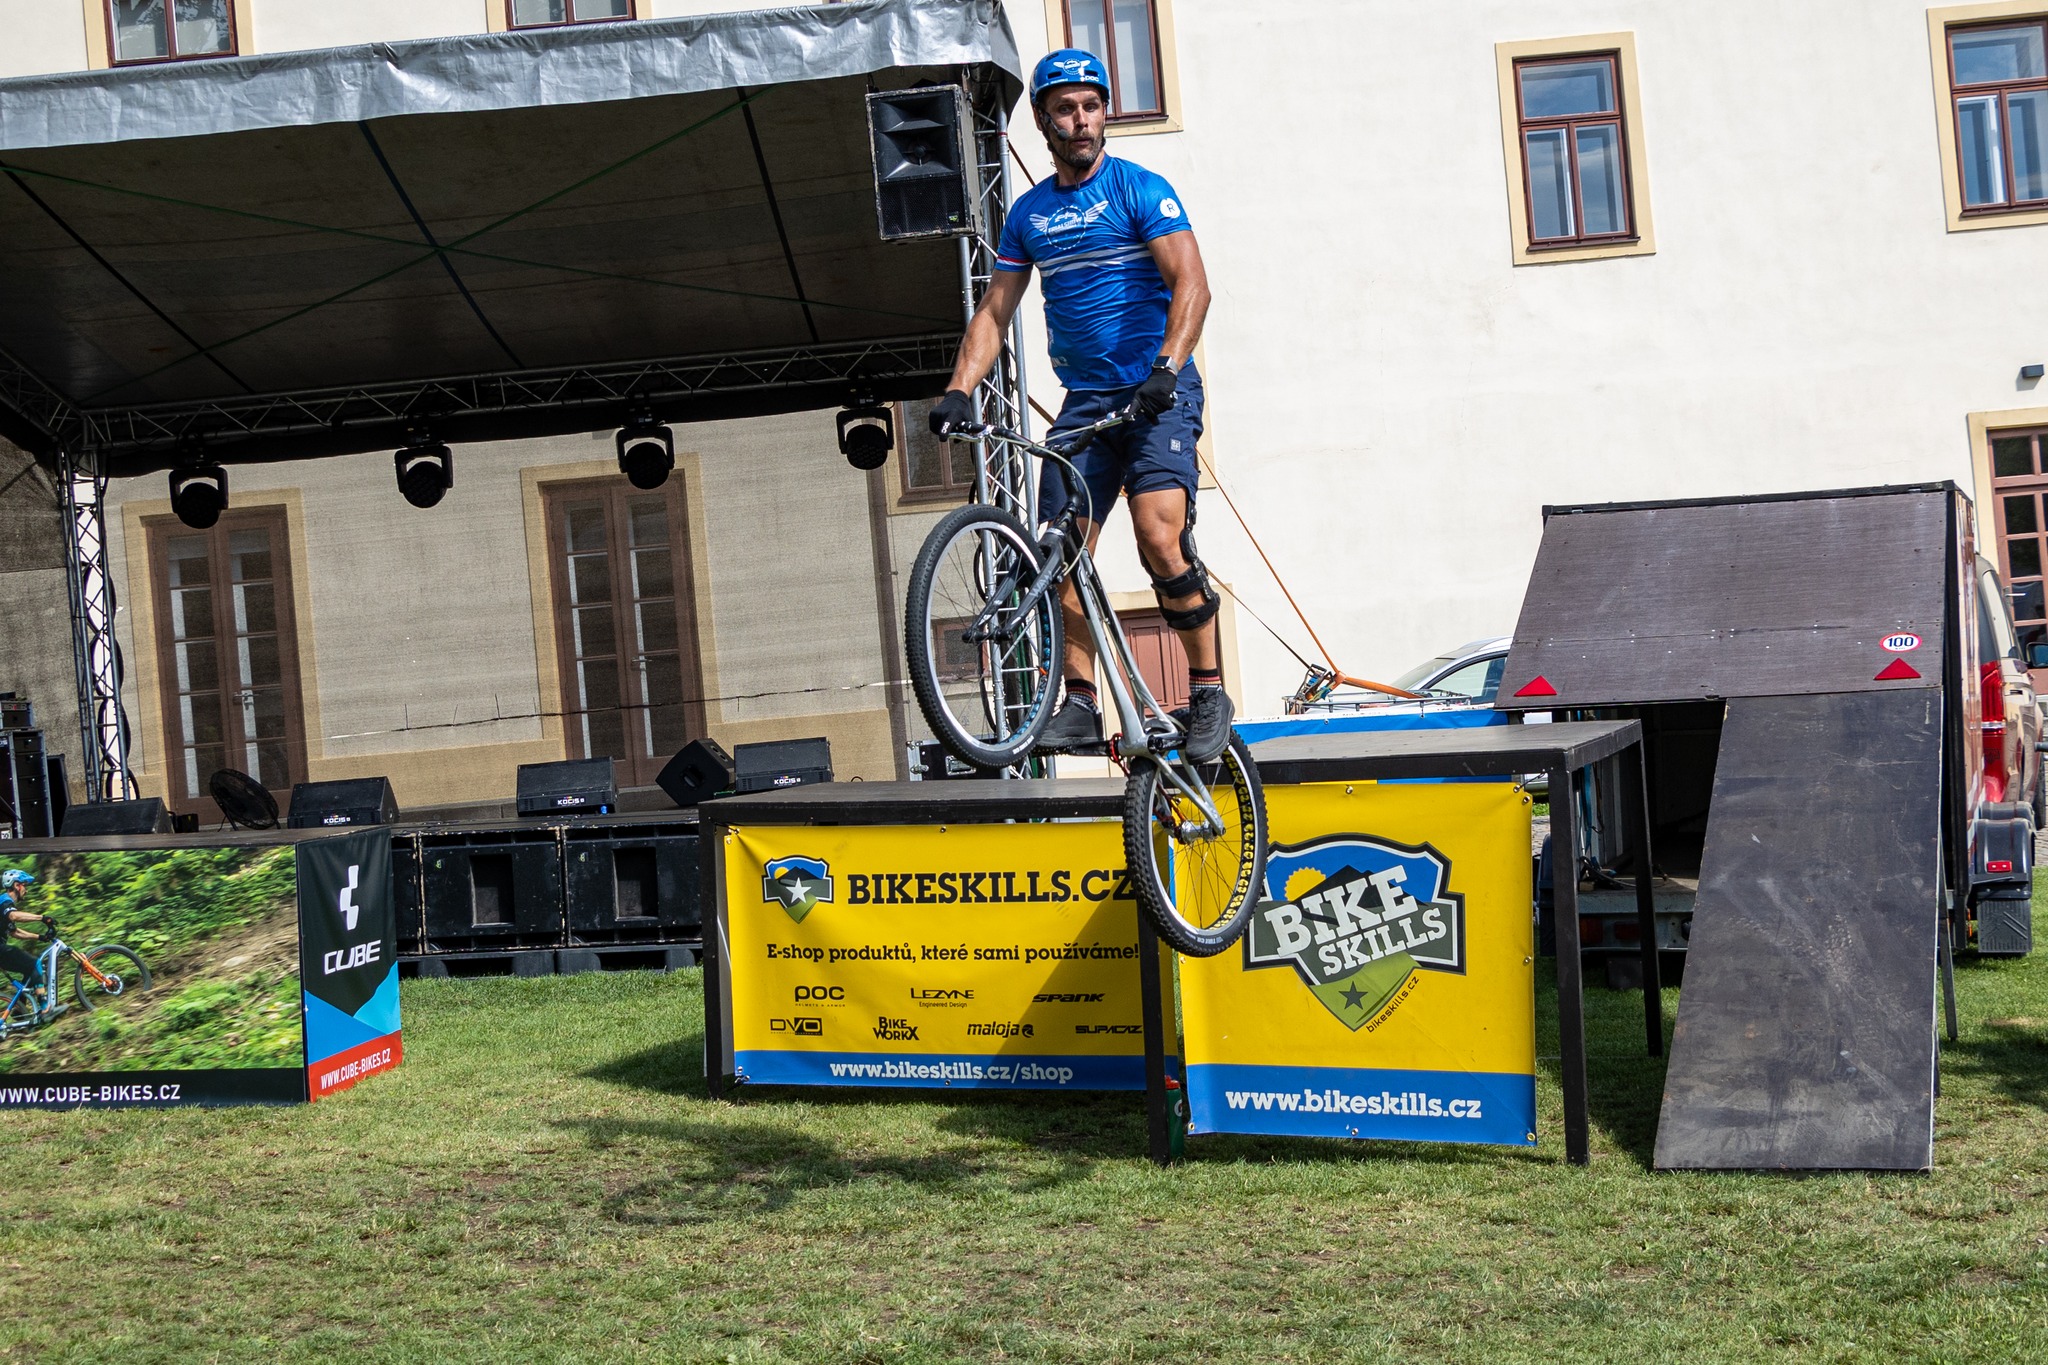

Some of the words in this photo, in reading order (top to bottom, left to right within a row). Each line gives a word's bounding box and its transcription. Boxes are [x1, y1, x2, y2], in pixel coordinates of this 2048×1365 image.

[1166, 203, 1175, 212] R
[1888, 636, 1914, 647] 100
[847, 869, 1138, 905] BIKESKILLS.CZ
[1264, 865, 1419, 957] BIKE
[1318, 907, 1447, 976] SKILLS
[324, 939, 382, 975] CUBE
[766, 943, 825, 963] E-shop
[829, 942, 917, 964] produktů,
[921, 944, 969, 961] které
[973, 944, 1020, 961] sami
[1025, 942, 1140, 964] používáme!
[910, 987, 975, 999] LEZYNE
[919, 1001, 948, 1009] Engineered
[1366, 976, 1419, 1033] bikeskills.cz
[770, 1018, 822, 1033] DVO
[878, 1016, 908, 1029] BIKE
[967, 1021, 1020, 1038] maloja
[321, 1048, 391, 1089] WWW.CUBE-BIKES.CZ
[830, 1061, 1073, 1084] www.bikeskills.cz/shop
[1225, 1089, 1482, 1118] www.bikeskills.cz
